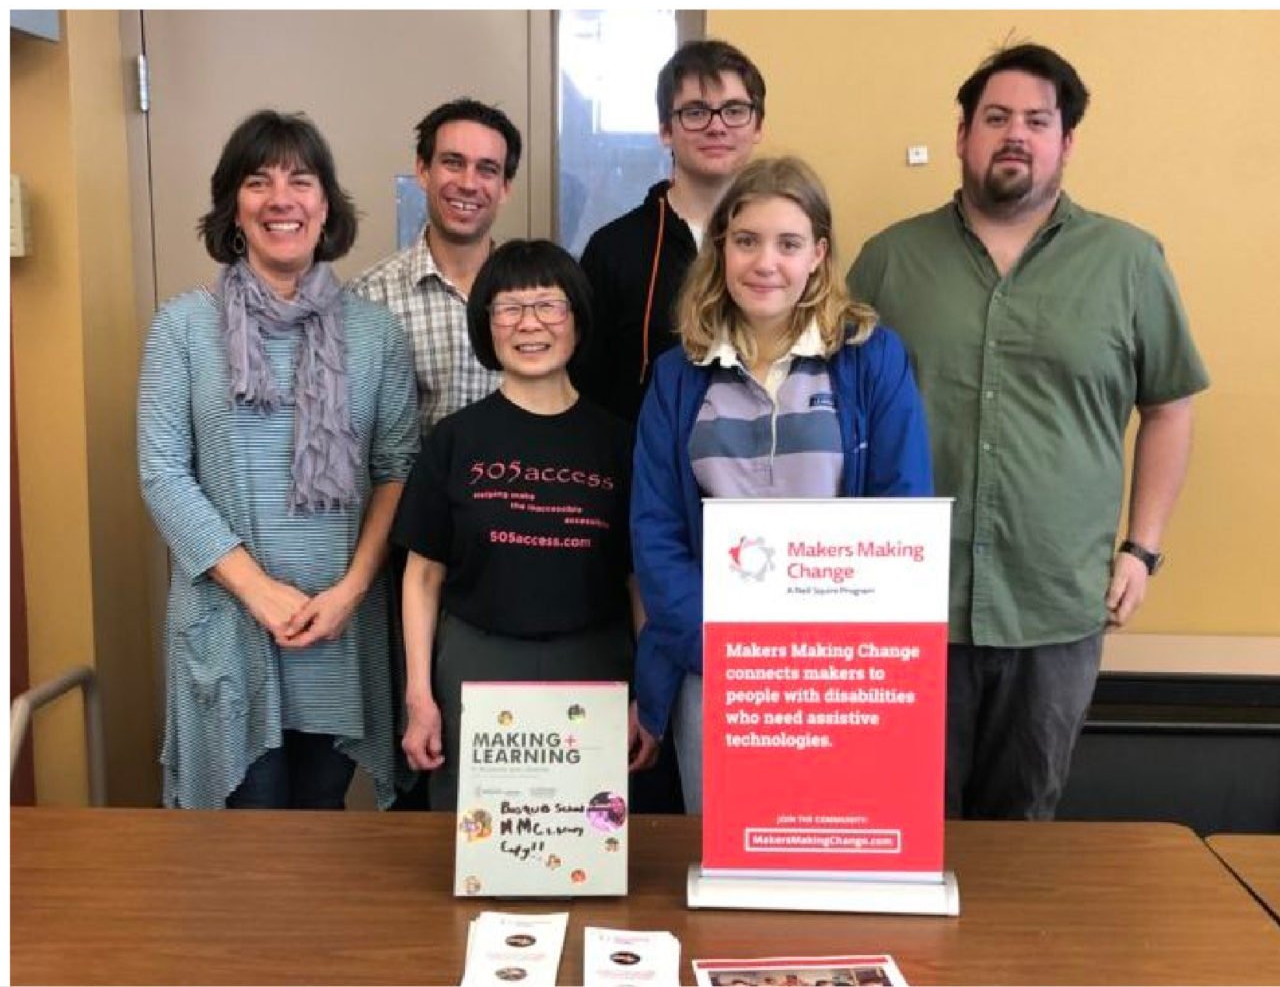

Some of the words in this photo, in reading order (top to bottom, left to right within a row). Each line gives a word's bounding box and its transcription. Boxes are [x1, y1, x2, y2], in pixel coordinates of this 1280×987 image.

[470, 461, 614, 489] 505access
[490, 531, 591, 548] 505access.com
[787, 542, 853, 557] Makers
[857, 542, 924, 562] Making
[787, 563, 854, 582] Change
[726, 644, 787, 657] Makers
[791, 644, 854, 661] Making
[858, 643, 920, 660] Change
[726, 668, 799, 680] connects
[803, 666, 865, 680] makers
[869, 667, 885, 680] to
[726, 688, 780, 704] people
[784, 689, 819, 703] with
[824, 688, 915, 703] disabilities
[726, 711, 759, 724] who
[764, 711, 803, 724] need
[806, 711, 879, 725] assistive
[472, 732, 561, 747] MAKING
[726, 733, 832, 749] technologies.
[473, 749, 581, 764] LEARNING
[752, 836, 893, 848] MakersMakingChange.com
